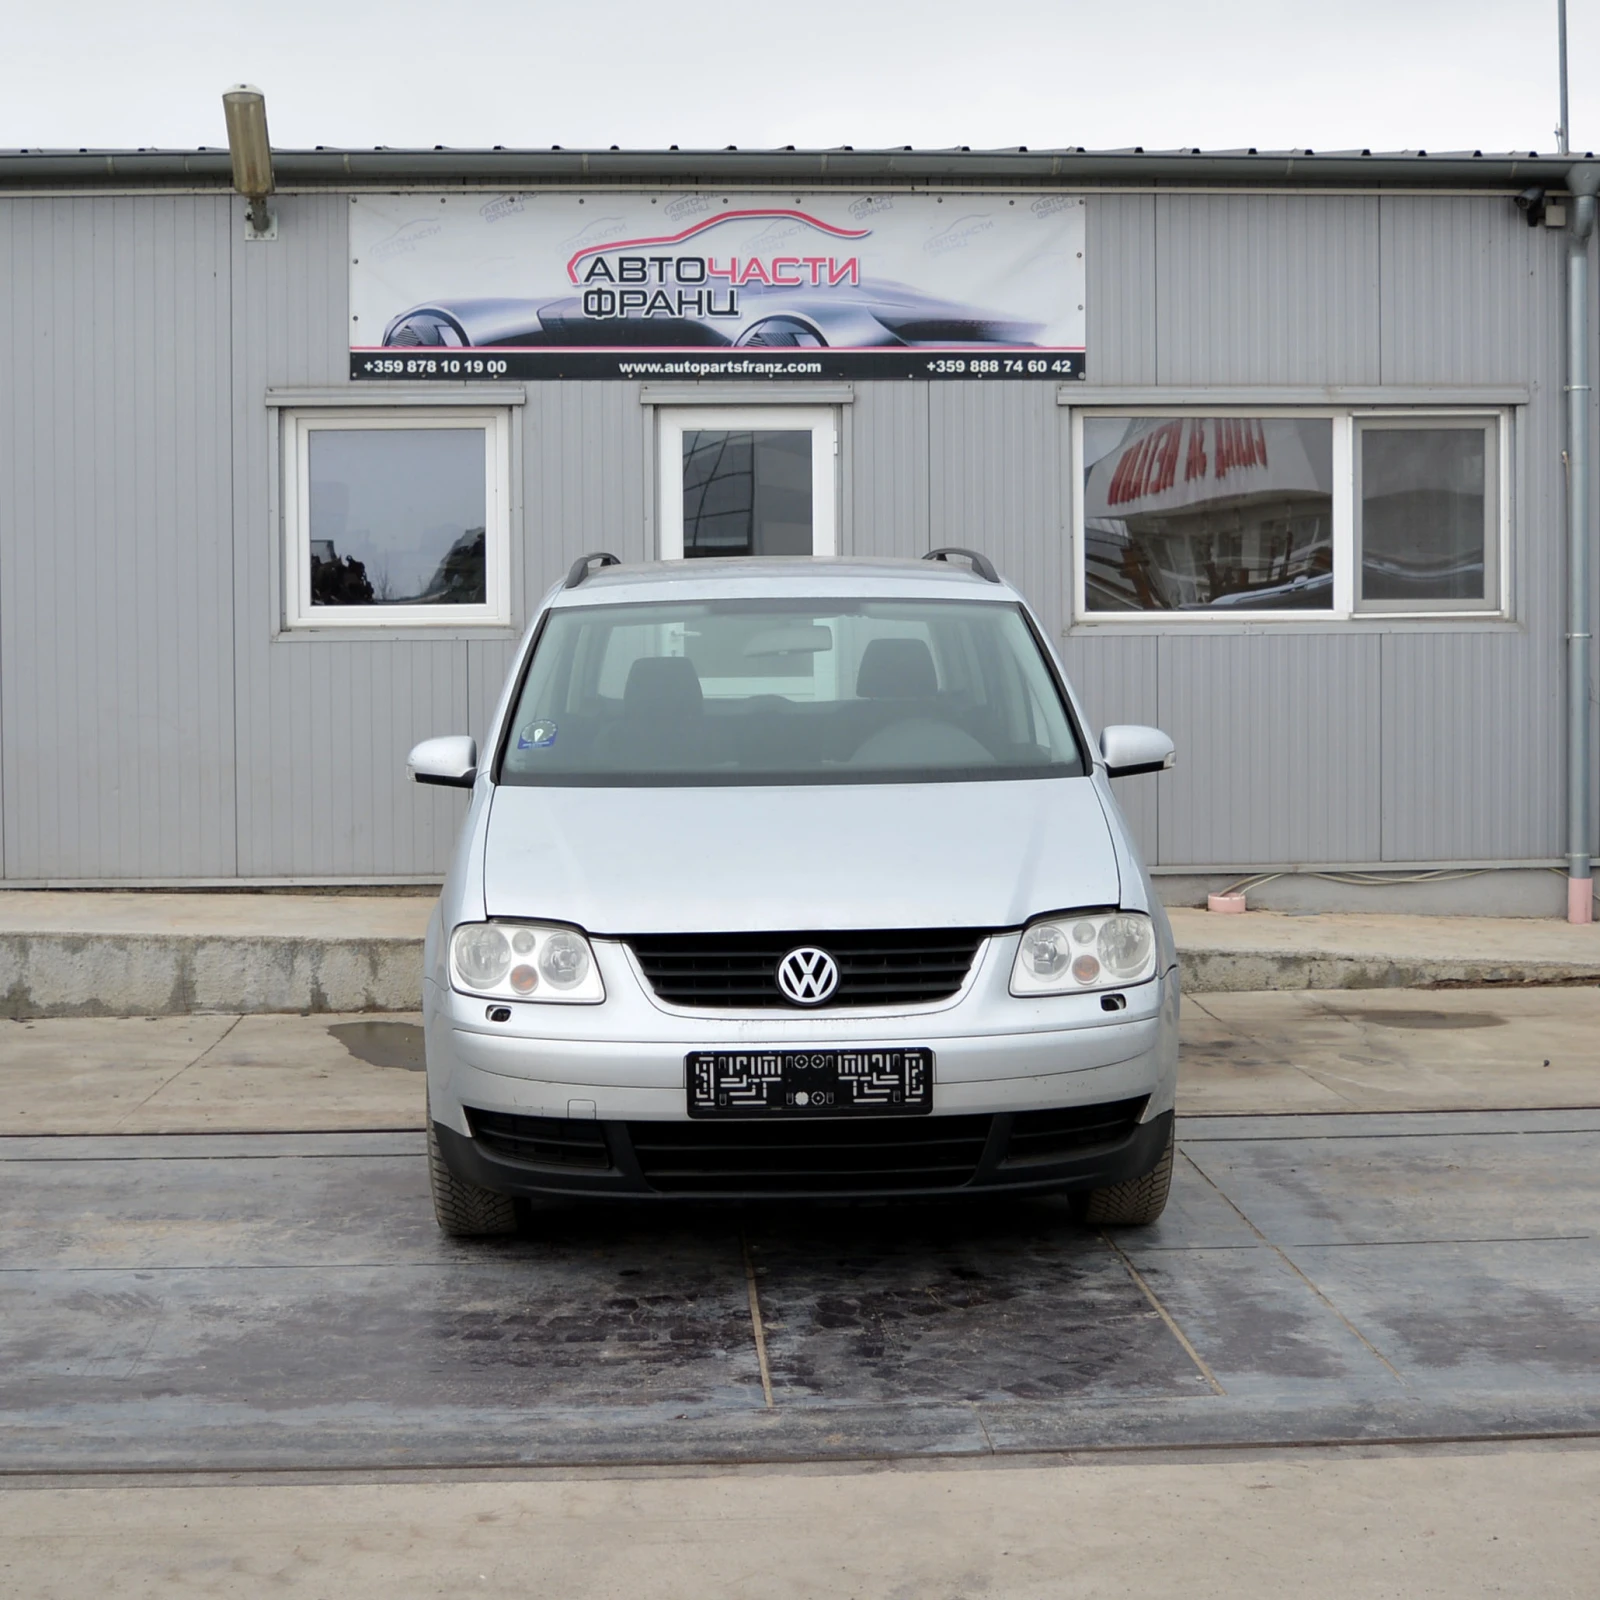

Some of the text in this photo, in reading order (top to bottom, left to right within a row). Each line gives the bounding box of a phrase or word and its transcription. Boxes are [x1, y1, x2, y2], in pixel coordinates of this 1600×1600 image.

[583, 256, 859, 285] АВТОЧАСТИ
[583, 287, 739, 319] ФРАНЦ
[364, 361, 507, 374] +359 878 10 19 00
[619, 361, 822, 377] www.autopartsfranz.com
[926, 360, 1071, 373] +359 888 74 60 42
[778, 947, 838, 1003] VW
